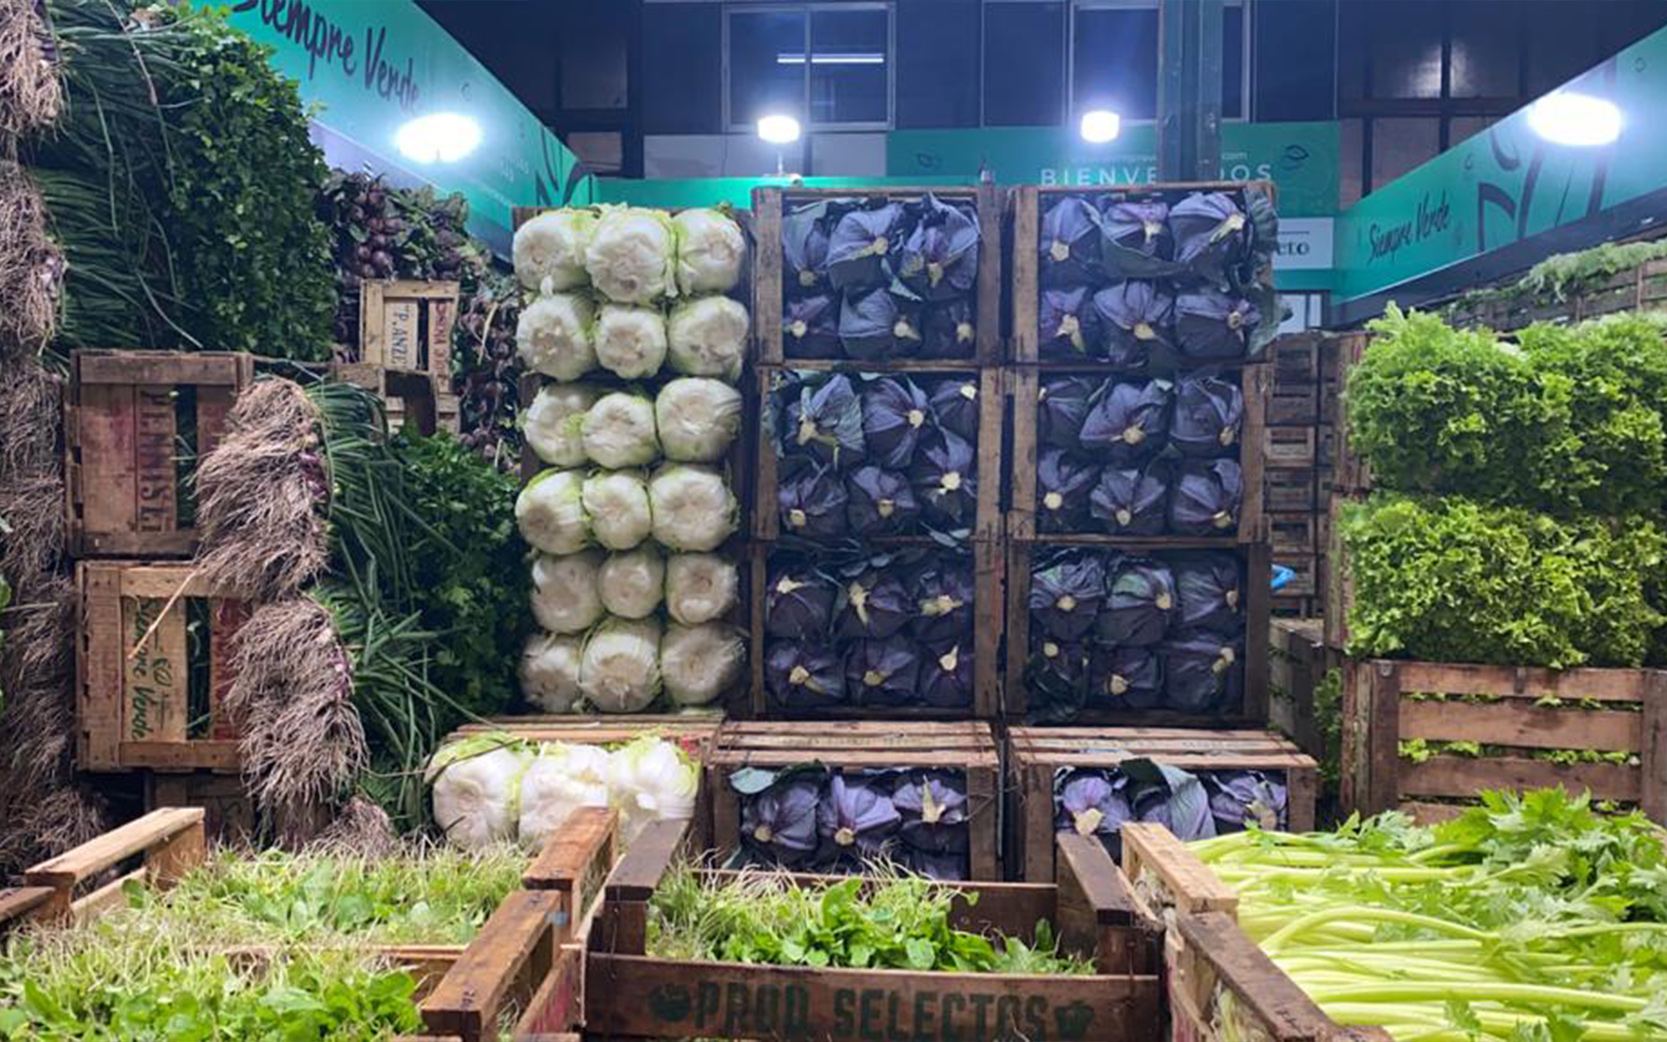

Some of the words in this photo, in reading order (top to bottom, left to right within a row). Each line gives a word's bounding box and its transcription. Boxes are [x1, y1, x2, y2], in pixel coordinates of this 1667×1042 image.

[233, 0, 356, 80] iempre
[364, 25, 421, 117] Verde
[1041, 163, 1272, 186] BIENVEOS
[1366, 221, 1413, 267] Siempre
[1415, 187, 1450, 242] Verde
[131, 685, 157, 741] Verde
[833, 987, 1049, 1042] SELECTOS
